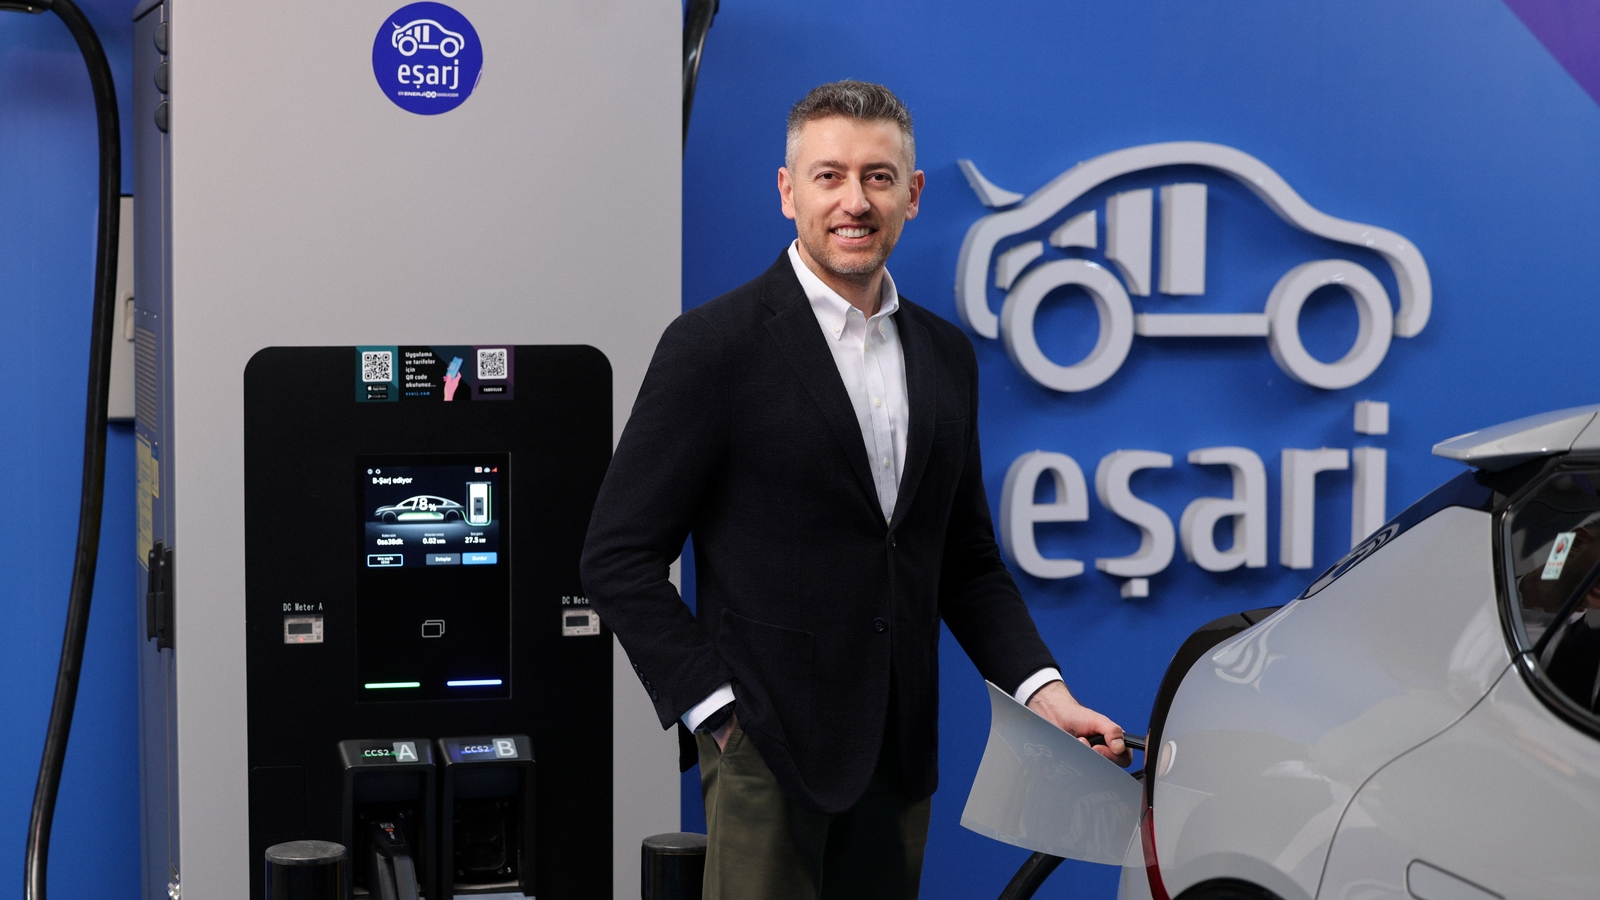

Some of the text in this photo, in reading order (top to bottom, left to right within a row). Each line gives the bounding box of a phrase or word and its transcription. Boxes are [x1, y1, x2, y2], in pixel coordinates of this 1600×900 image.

[397, 59, 459, 90] eşarj
[372, 477, 413, 485] B-Şarj ediyor
[283, 602, 323, 612] DC Meter A
[561, 596, 589, 605] DC Mete
[364, 744, 417, 760] CCS2 A
[464, 740, 516, 757] CCS2 B
